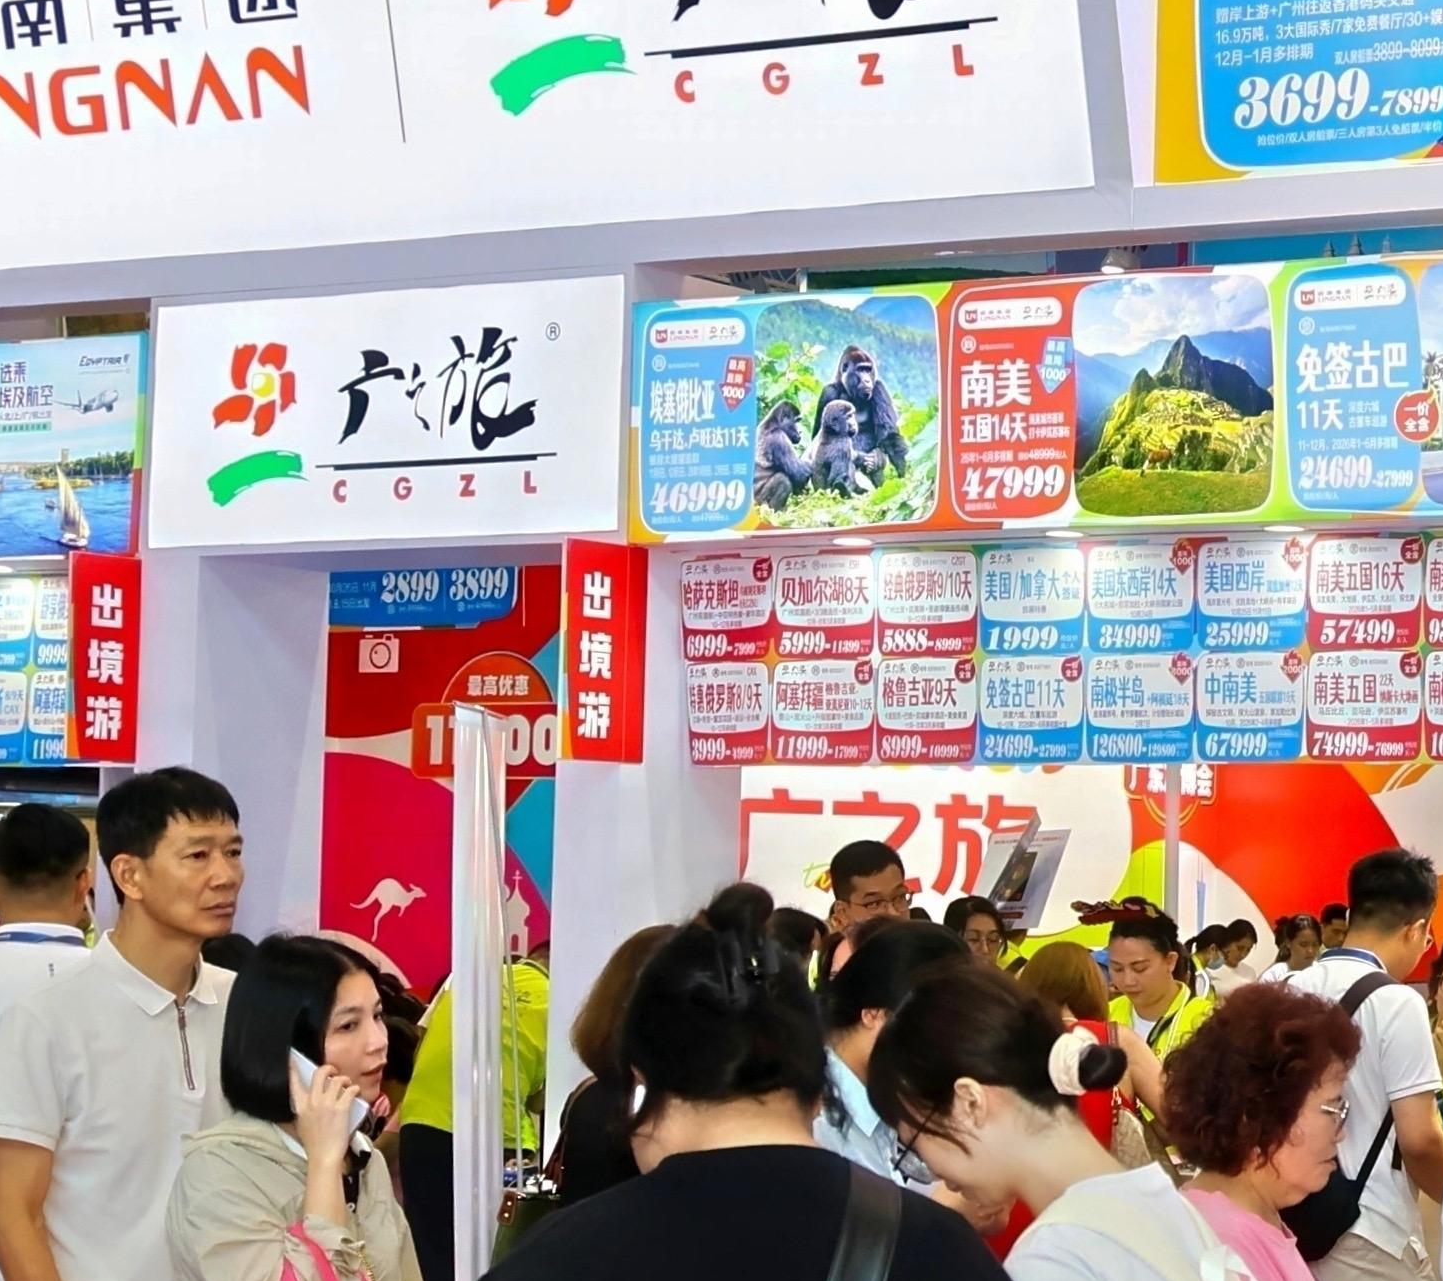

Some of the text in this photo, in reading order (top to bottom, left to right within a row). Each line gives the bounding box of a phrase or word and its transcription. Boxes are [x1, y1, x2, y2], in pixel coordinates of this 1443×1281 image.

[959, 357, 1032, 408] 南美
[1296, 340, 1409, 394] 免签古巴
[338, 327, 541, 450] 广之旅
[649, 377, 715, 424] 埃塞俄比亚
[959, 413, 1028, 444] 五国14天
[1297, 398, 1345, 430] 11天
[651, 477, 747, 514] 46999
[960, 465, 1066, 501] 47999
[381, 570, 439, 604] 2899
[449, 568, 509, 603] 3899
[780, 574, 870, 607] 贝加尔湖8天
[1317, 561, 1406, 594] 南美五国16天
[986, 625, 1058, 651] 1999
[1320, 620, 1395, 644] 57499
[85, 583, 125, 742] 出境游
[577, 571, 613, 741] 出境游
[467, 675, 529, 697] 最高优惠
[741, 789, 1038, 896] 广之旅
